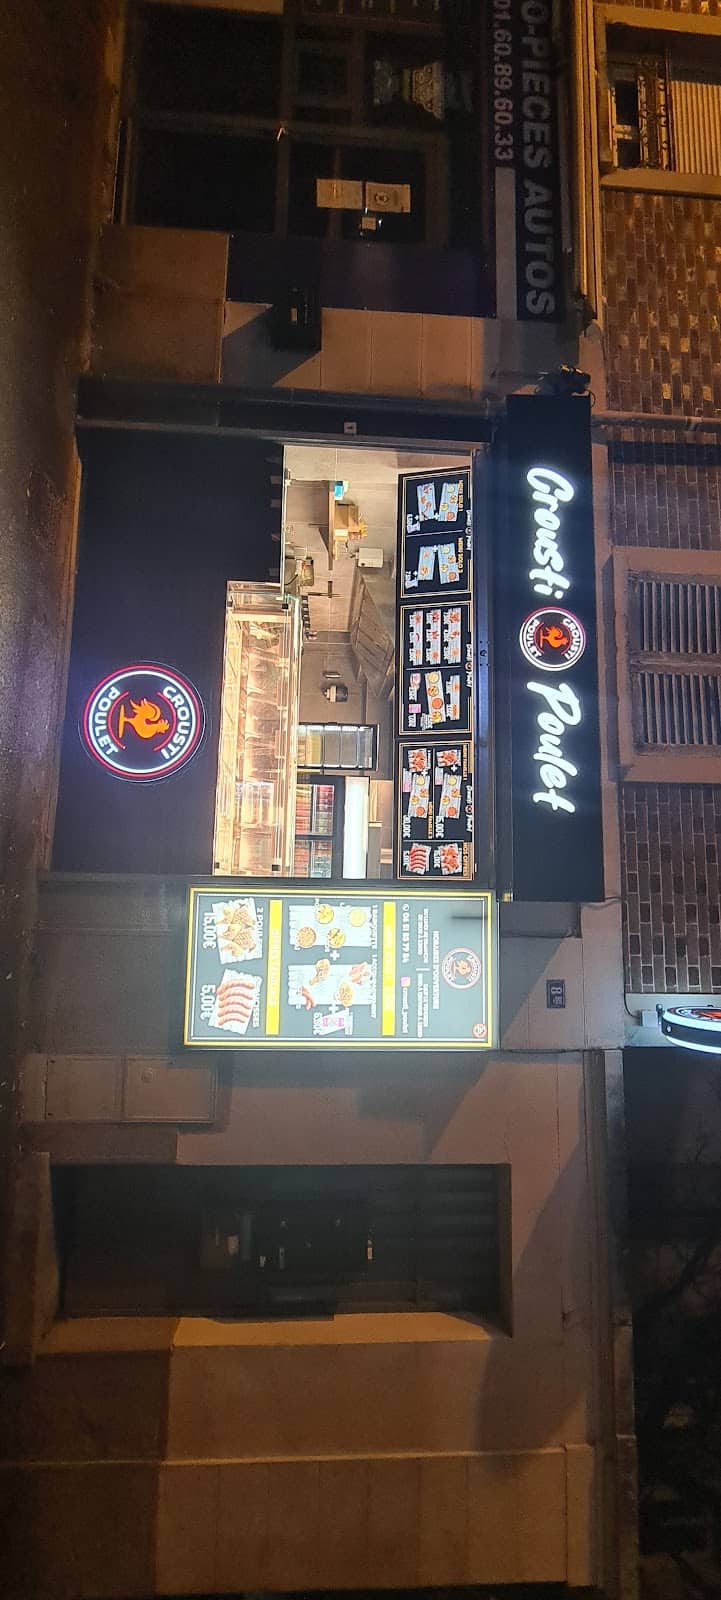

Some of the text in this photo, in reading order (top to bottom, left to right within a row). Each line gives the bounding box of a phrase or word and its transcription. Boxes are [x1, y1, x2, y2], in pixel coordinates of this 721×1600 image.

[493, 0, 514, 160] 01.60.89.60.33
[524, 180, 556, 315] AUTOS
[526, 618, 542, 658] POULET
[526, 467, 582, 813] Crousti Poulet
[562, 618, 580, 660] CROUSTI
[94, 686, 122, 756] POULET
[160, 686, 191, 760] CROUSTI
[202, 912, 216, 948] 15,00€
[200, 984, 216, 1020] 5,00€
